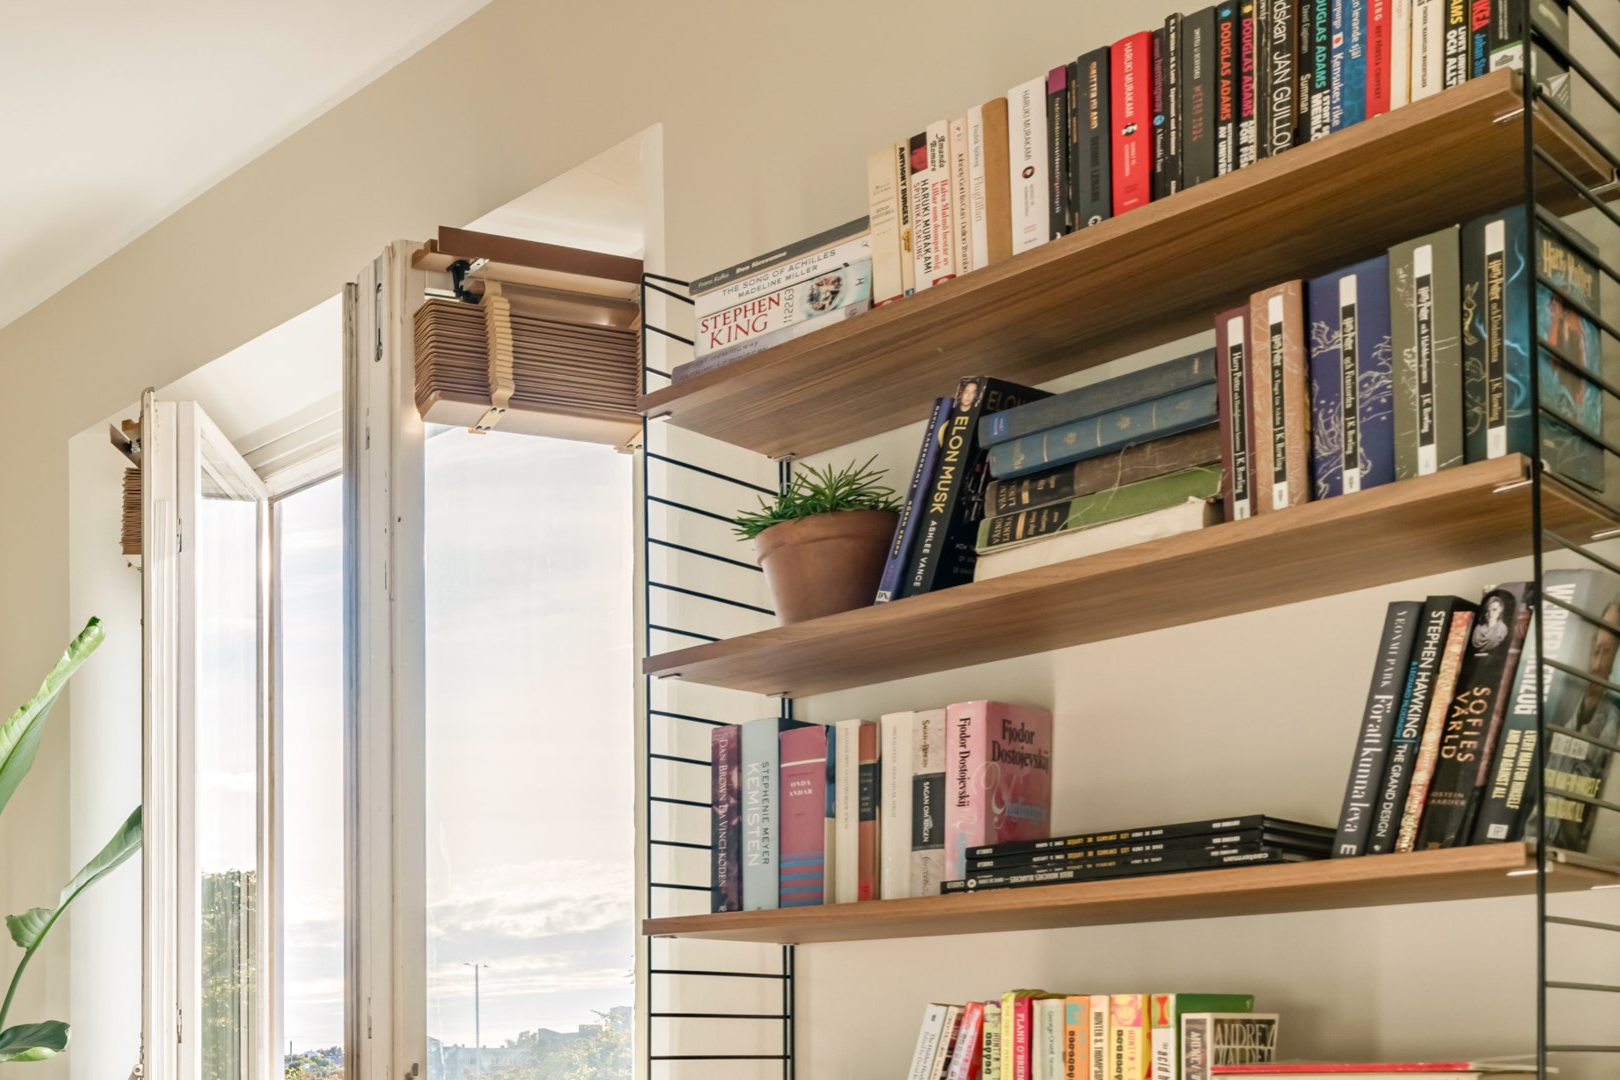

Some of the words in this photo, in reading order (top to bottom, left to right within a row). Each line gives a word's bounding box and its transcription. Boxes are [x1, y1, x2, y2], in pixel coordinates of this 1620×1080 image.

[1124, 42, 1134, 74] HARUKI
[1220, 22, 1232, 75] DOUGLAS
[1242, 18, 1253, 72] DOUGLAS
[1300, 73, 1311, 114] Summan
[1332, 52, 1344, 103] Kensukes
[1022, 90, 1031, 118] HARUKI
[1123, 75, 1134, 118] MURAKAMI
[1220, 80, 1232, 121] ADAMS
[1242, 76, 1253, 117] ADAMS
[1332, 105, 1343, 127] rike
[936, 134, 947, 168] Amanda
[1022, 119, 1032, 161] MURAKAMI
[899, 147, 908, 187] ANTHONY
[900, 189, 909, 226] BURGESS
[919, 178, 931, 216] HARUKI
[922, 219, 933, 275] MURAKAMI
[721, 284, 740, 297] THE
[741, 273, 770, 288] SONG
[771, 267, 786, 278] OF
[787, 249, 836, 272] ACHILLES
[737, 278, 782, 299] MADELINE
[784, 264, 819, 281] MILLER
[700, 293, 781, 334] STEPHEN
[709, 312, 769, 350] KING
[944, 415, 970, 463] ELON
[929, 465, 958, 517] MUSK
[921, 520, 938, 555] ASHLEE
[913, 556, 928, 588] VANCE
[1386, 610, 1407, 655] YEONMI
[1417, 610, 1446, 669] STEPHEN
[1379, 658, 1396, 688] PARK
[1370, 693, 1395, 721] För
[1401, 671, 1430, 739] HAWKING
[959, 717, 972, 750] Fjodor
[1001, 719, 1036, 746] Fjodor
[1369, 723, 1390, 744] att
[1440, 690, 1471, 760] VÄRLD
[1457, 686, 1492, 763] SOFIES
[1508, 729, 1522, 744] AND
[1520, 730, 1537, 751] EVERY
[718, 739, 728, 761] DAN
[991, 740, 1051, 775] Dostojevskij
[1393, 744, 1408, 763] THE
[1504, 745, 1518, 758] GOD
[1518, 752, 1532, 767] MAN
[718, 764, 728, 801] BROWN
[956, 750, 972, 809] Dostojevskij
[1350, 747, 1384, 798] kunna
[1384, 764, 1403, 800] GRAND
[1495, 759, 1516, 783] AGAINST
[1514, 768, 1529, 781] FOR
[761, 762, 770, 824] STEPHENIE
[922, 782, 930, 805] SAGAN
[1491, 784, 1508, 799] ALL
[1507, 781, 1527, 810] HIMSELF
[747, 763, 760, 868] KEMISTEN
[923, 805, 930, 818] OM
[1342, 802, 1370, 833] leva
[1375, 801, 1394, 838] DESIGN
[762, 827, 770, 866] MEYER
[1016, 1013, 1026, 1043] FLANN
[1093, 1012, 1103, 1037] HUNTER
[1017, 1045, 1026, 1080] O'BRIEN
[1157, 1050, 1170, 1073] acid
